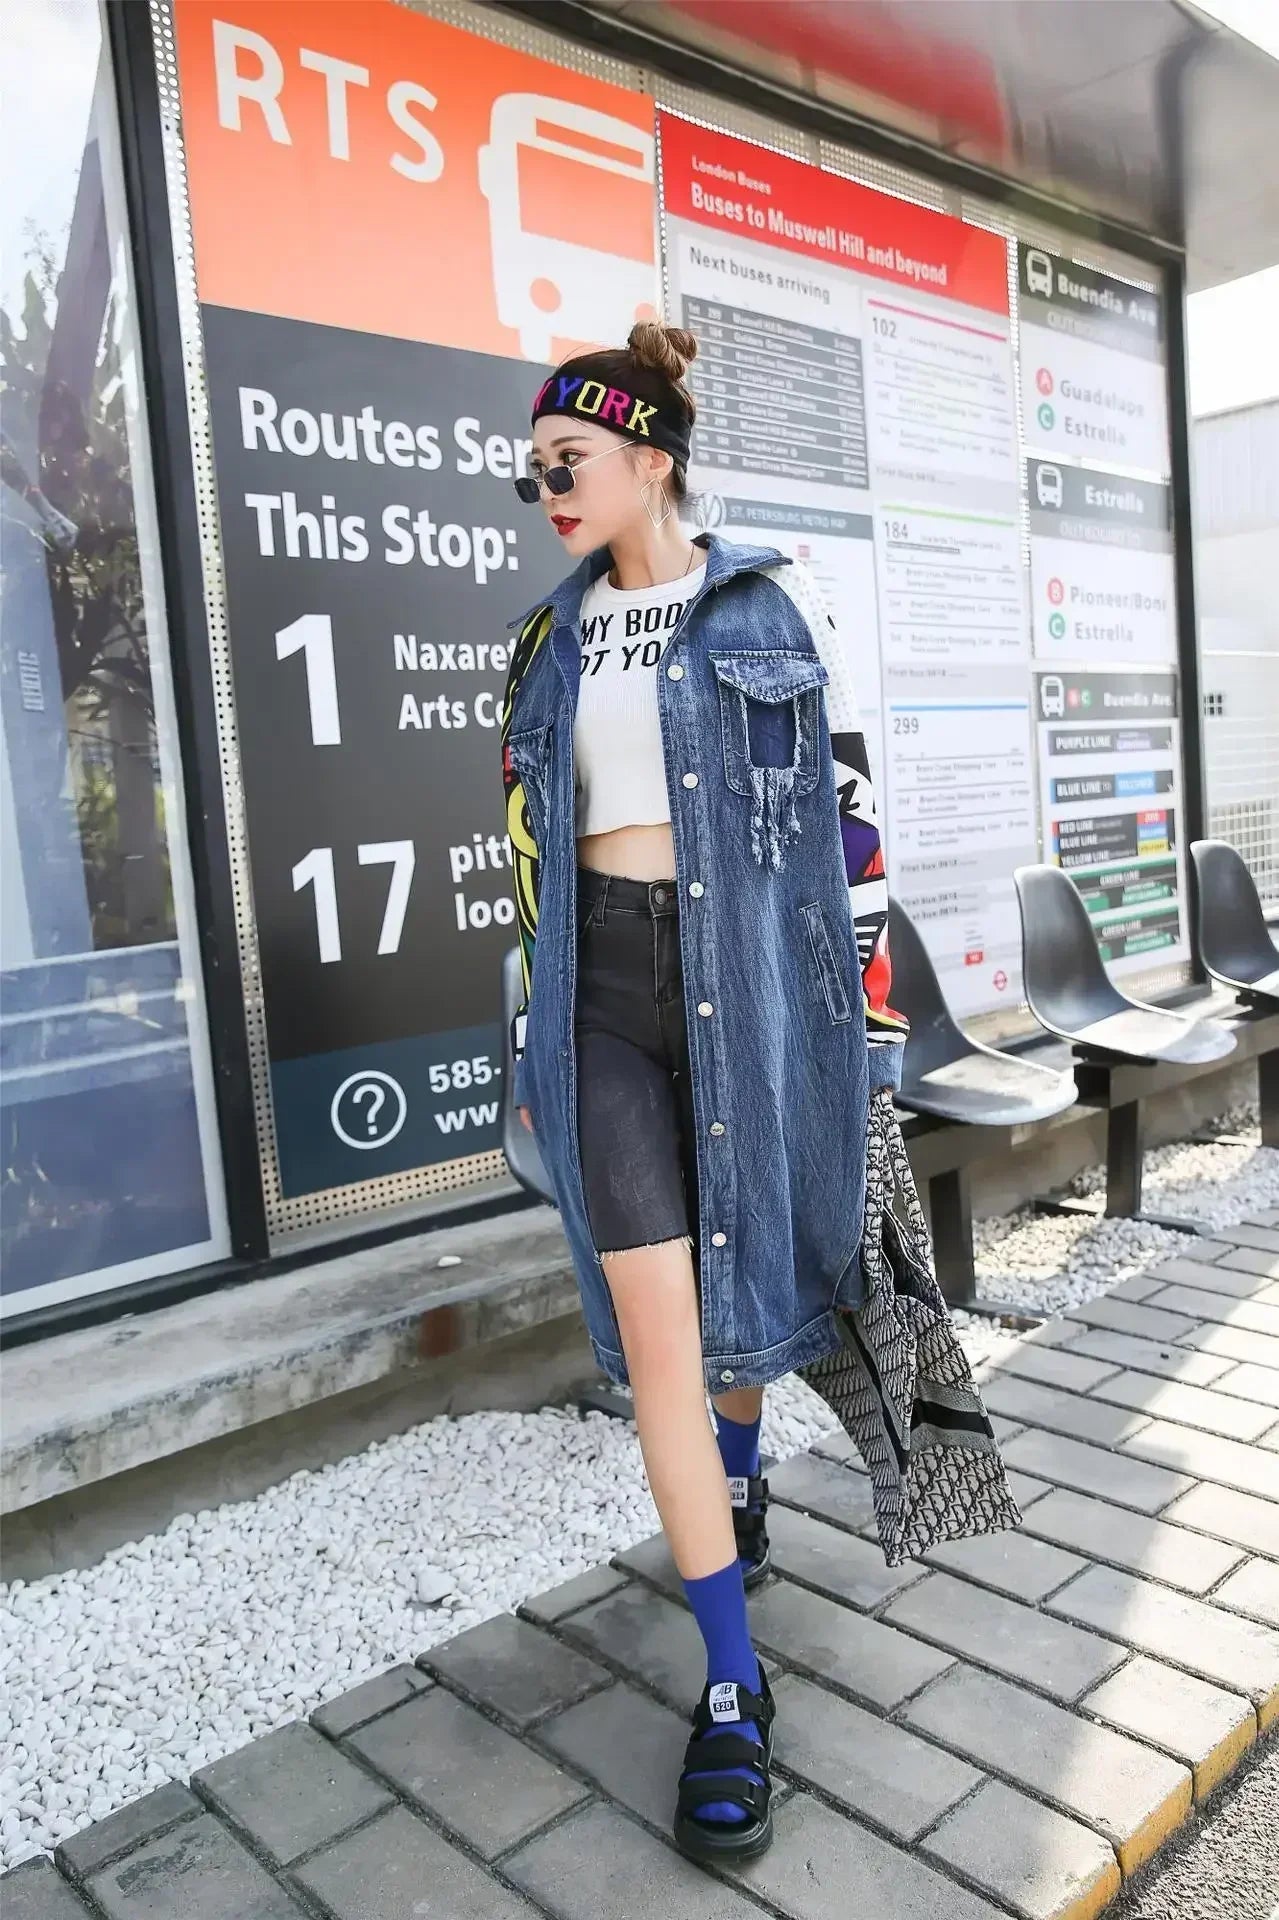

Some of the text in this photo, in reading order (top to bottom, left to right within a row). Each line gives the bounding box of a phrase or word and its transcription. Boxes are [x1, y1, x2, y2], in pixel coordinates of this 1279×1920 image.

[212, 18, 445, 183] RTS
[691, 155, 772, 195] London Buses
[691, 181, 948, 286] Buses to Muswell Hill and beyond
[690, 246, 831, 305] Next buses arriving
[872, 316, 898, 339] 102
[555, 376, 659, 437] YORK
[238, 386, 443, 471] Routes
[1064, 416, 1127, 446] Estrella
[1084, 484, 1144, 514] Estrella
[245, 491, 519, 585] This Stop:
[884, 520, 908, 540] 184
[581, 613, 614, 647] MY
[1074, 622, 1134, 643] Estrella
[275, 614, 343, 746] 1
[398, 693, 468, 730] Arts
[893, 717, 920, 735] 299
[1090, 734, 1111, 748] LINE
[1056, 782, 1081, 797] BLUE
[1081, 780, 1101, 794] LINE
[1059, 821, 1076, 834] RED
[1075, 819, 1093, 833] LINE
[1059, 833, 1098, 850] BLUE LINE
[292, 839, 416, 964] 17
[455, 892, 516, 931] loo
